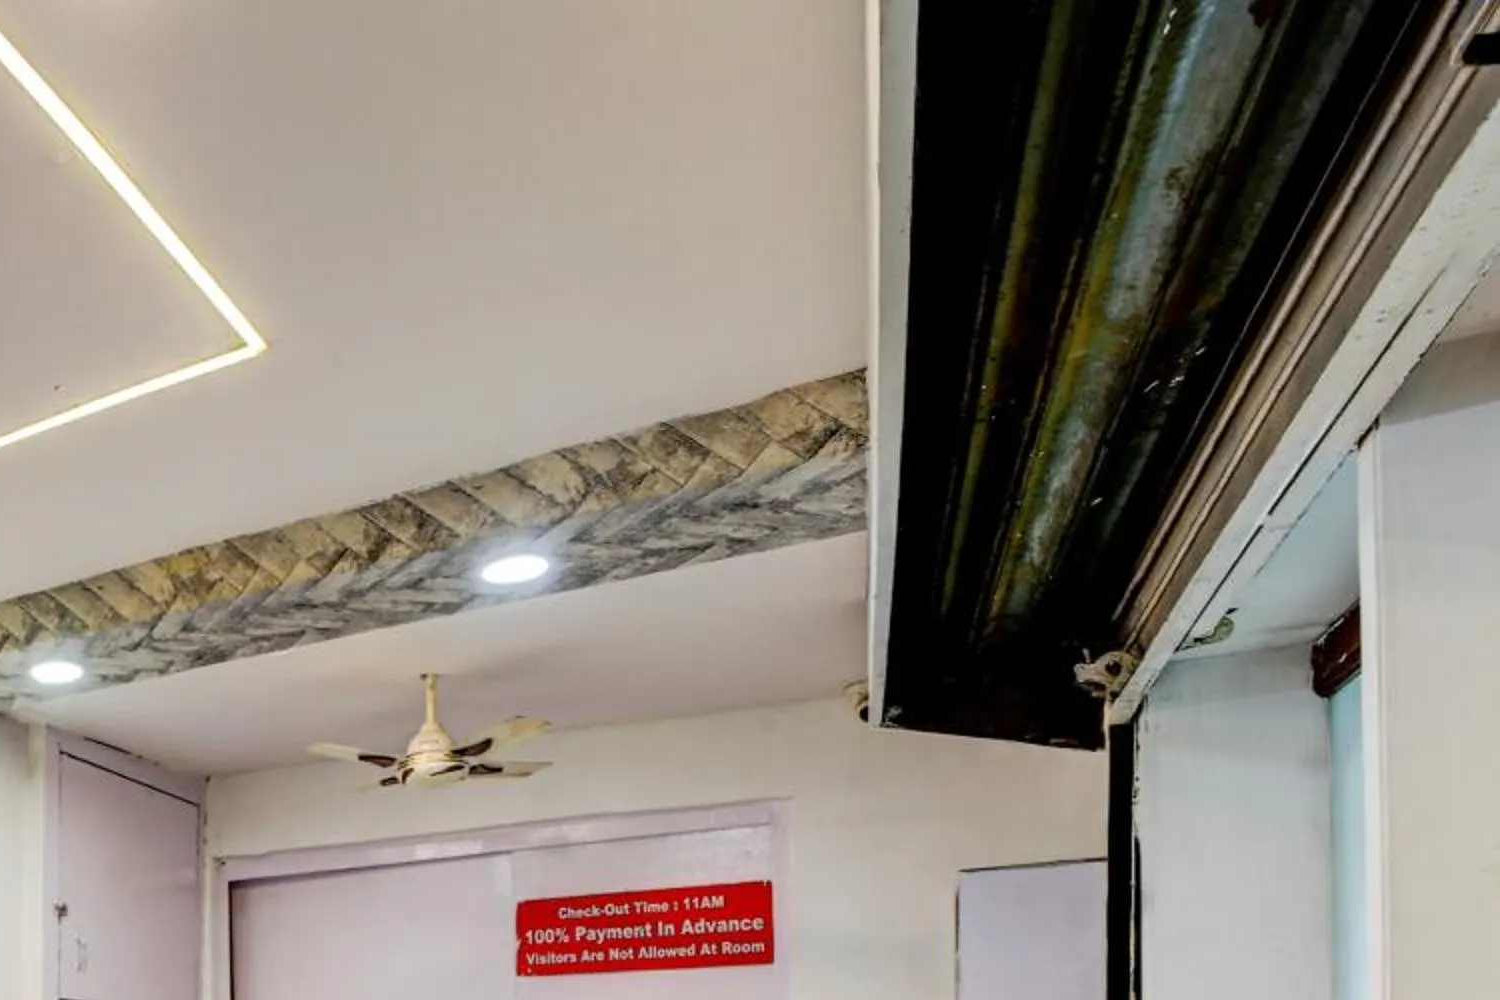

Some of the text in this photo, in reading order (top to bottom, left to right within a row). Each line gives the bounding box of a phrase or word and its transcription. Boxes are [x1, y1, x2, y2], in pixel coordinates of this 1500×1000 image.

[558, 903, 629, 919] Check-Out
[634, 900, 669, 913] Time
[683, 895, 725, 910] 11AM
[525, 917, 765, 944] 100% Payment In Advance
[525, 941, 765, 965] Visitors Are Not Allowed At Room
